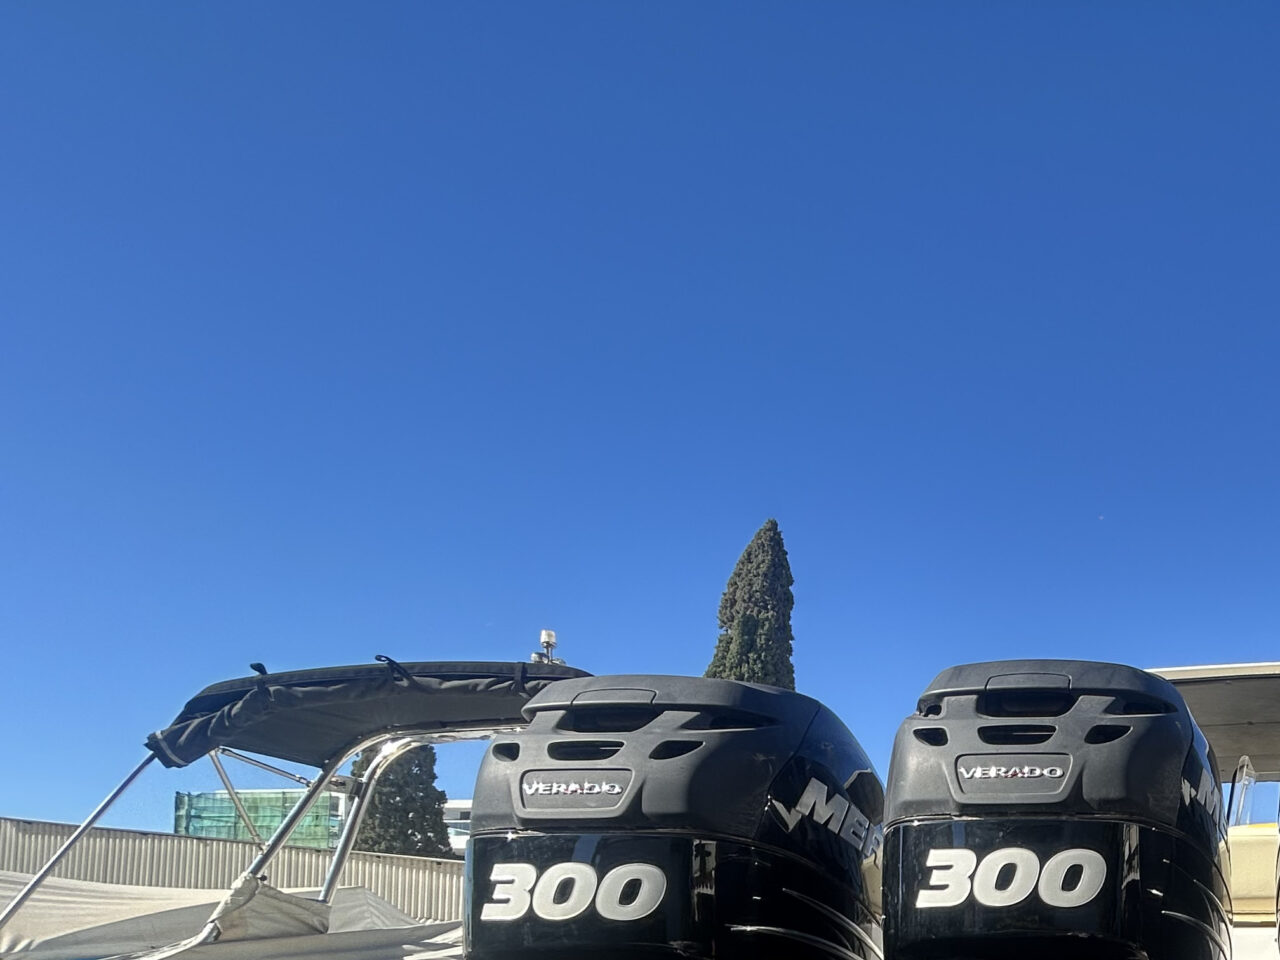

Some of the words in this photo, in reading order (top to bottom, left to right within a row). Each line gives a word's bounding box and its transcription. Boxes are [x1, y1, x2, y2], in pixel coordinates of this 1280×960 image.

[522, 780, 623, 796] VERADO
[959, 765, 1064, 780] VERADO
[480, 861, 668, 922] 300
[915, 847, 1107, 909] 300
